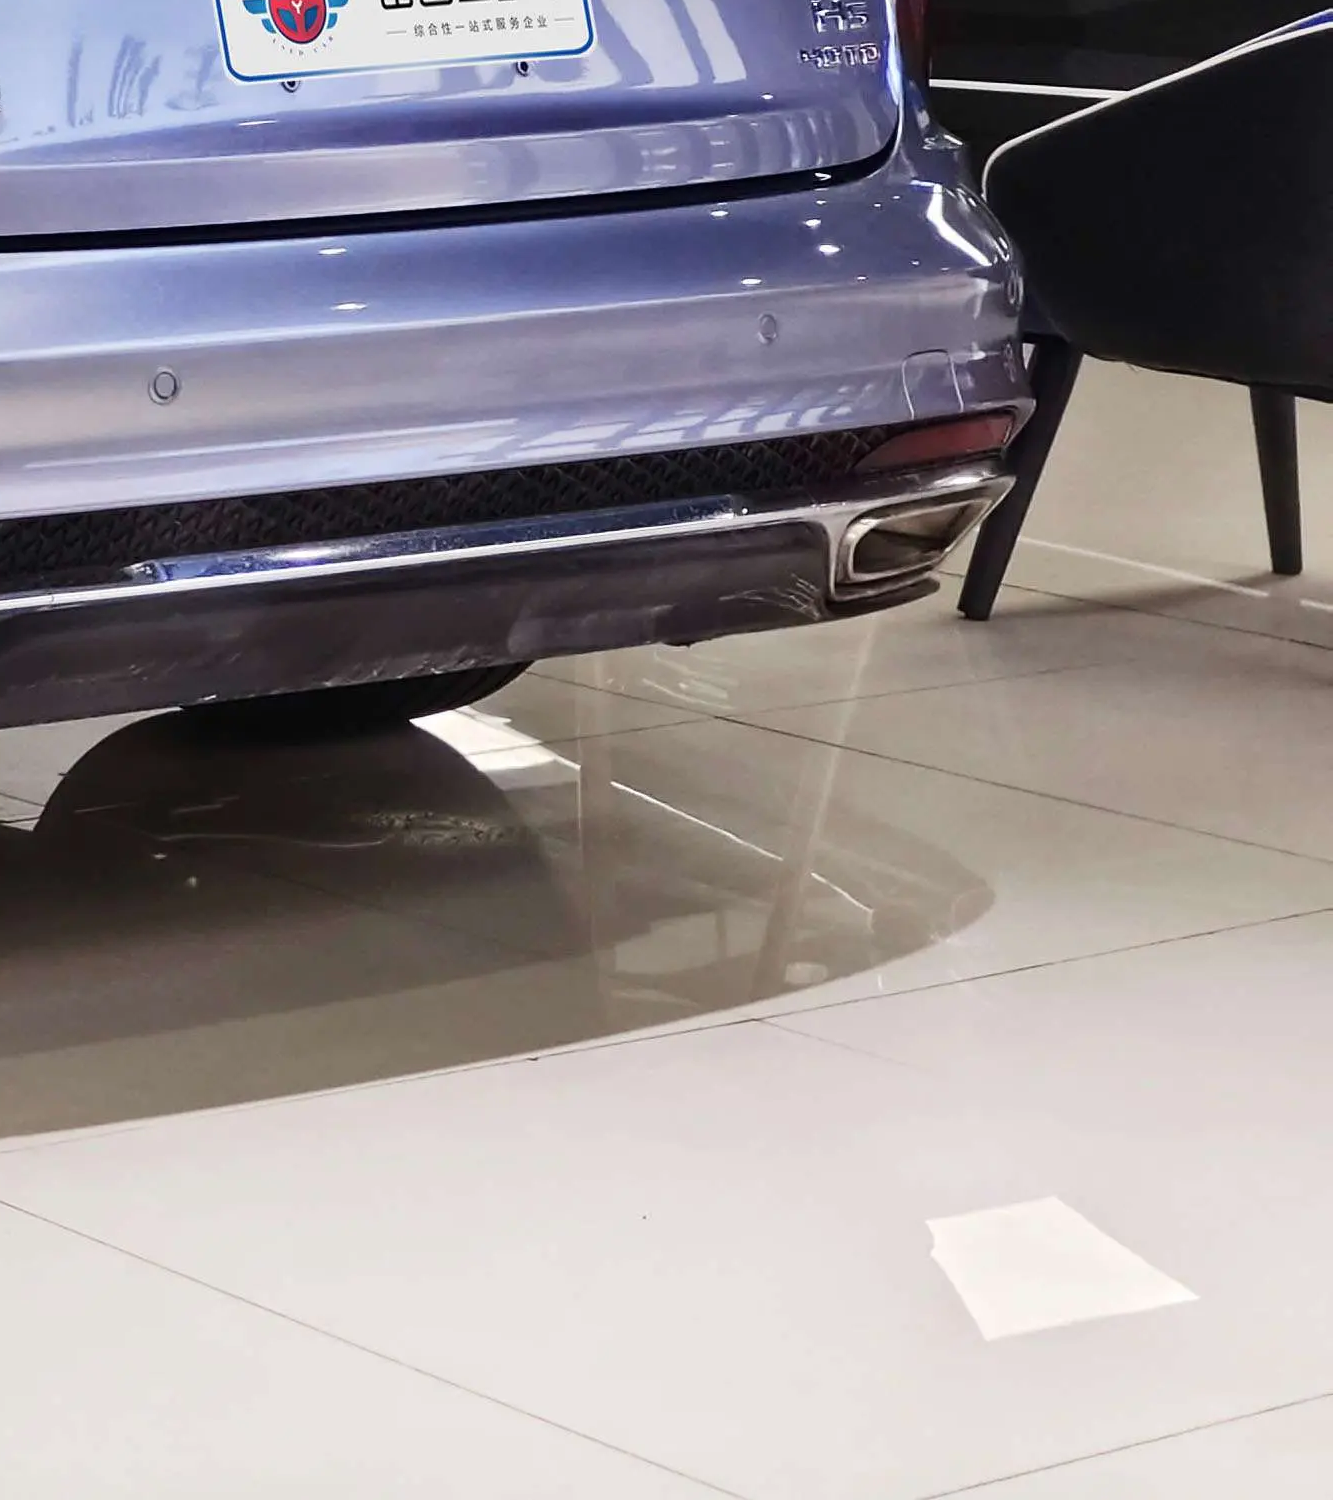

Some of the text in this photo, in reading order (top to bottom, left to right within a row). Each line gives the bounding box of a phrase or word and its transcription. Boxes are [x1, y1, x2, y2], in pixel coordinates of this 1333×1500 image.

[413, 14, 549, 38] 综合性一站式服务企业
